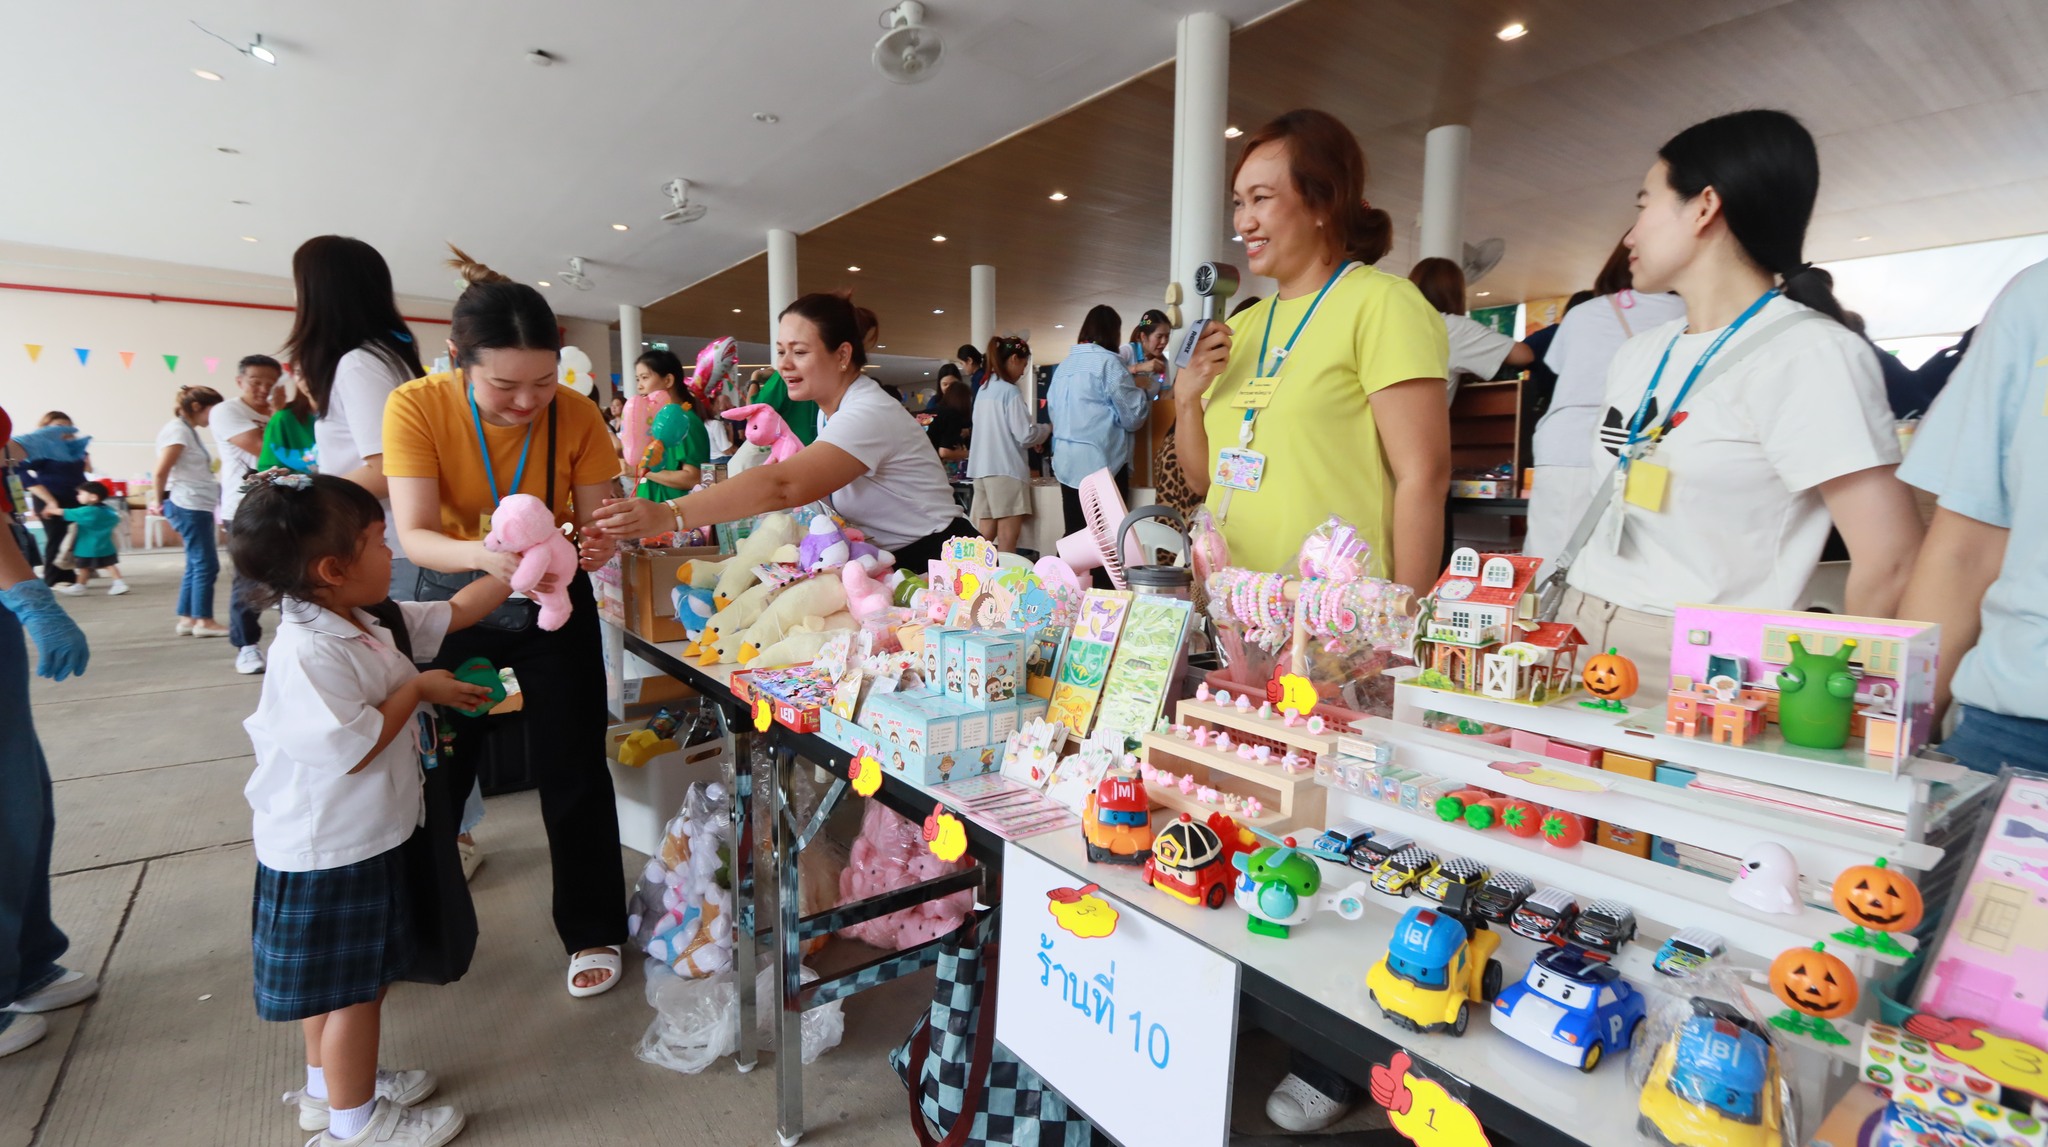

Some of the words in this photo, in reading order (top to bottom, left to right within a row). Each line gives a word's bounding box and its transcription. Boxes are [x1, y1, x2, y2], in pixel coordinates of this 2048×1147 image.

[780, 707, 795, 724] LED
[1118, 784, 1132, 799] M
[1410, 929, 1424, 945] B
[1037, 933, 1116, 1035] ร้านที่
[1128, 1010, 1170, 1070] 10
[1608, 1014, 1623, 1044] P
[2001, 1048, 2043, 1075] 3
[1424, 1107, 1439, 1132] 1
